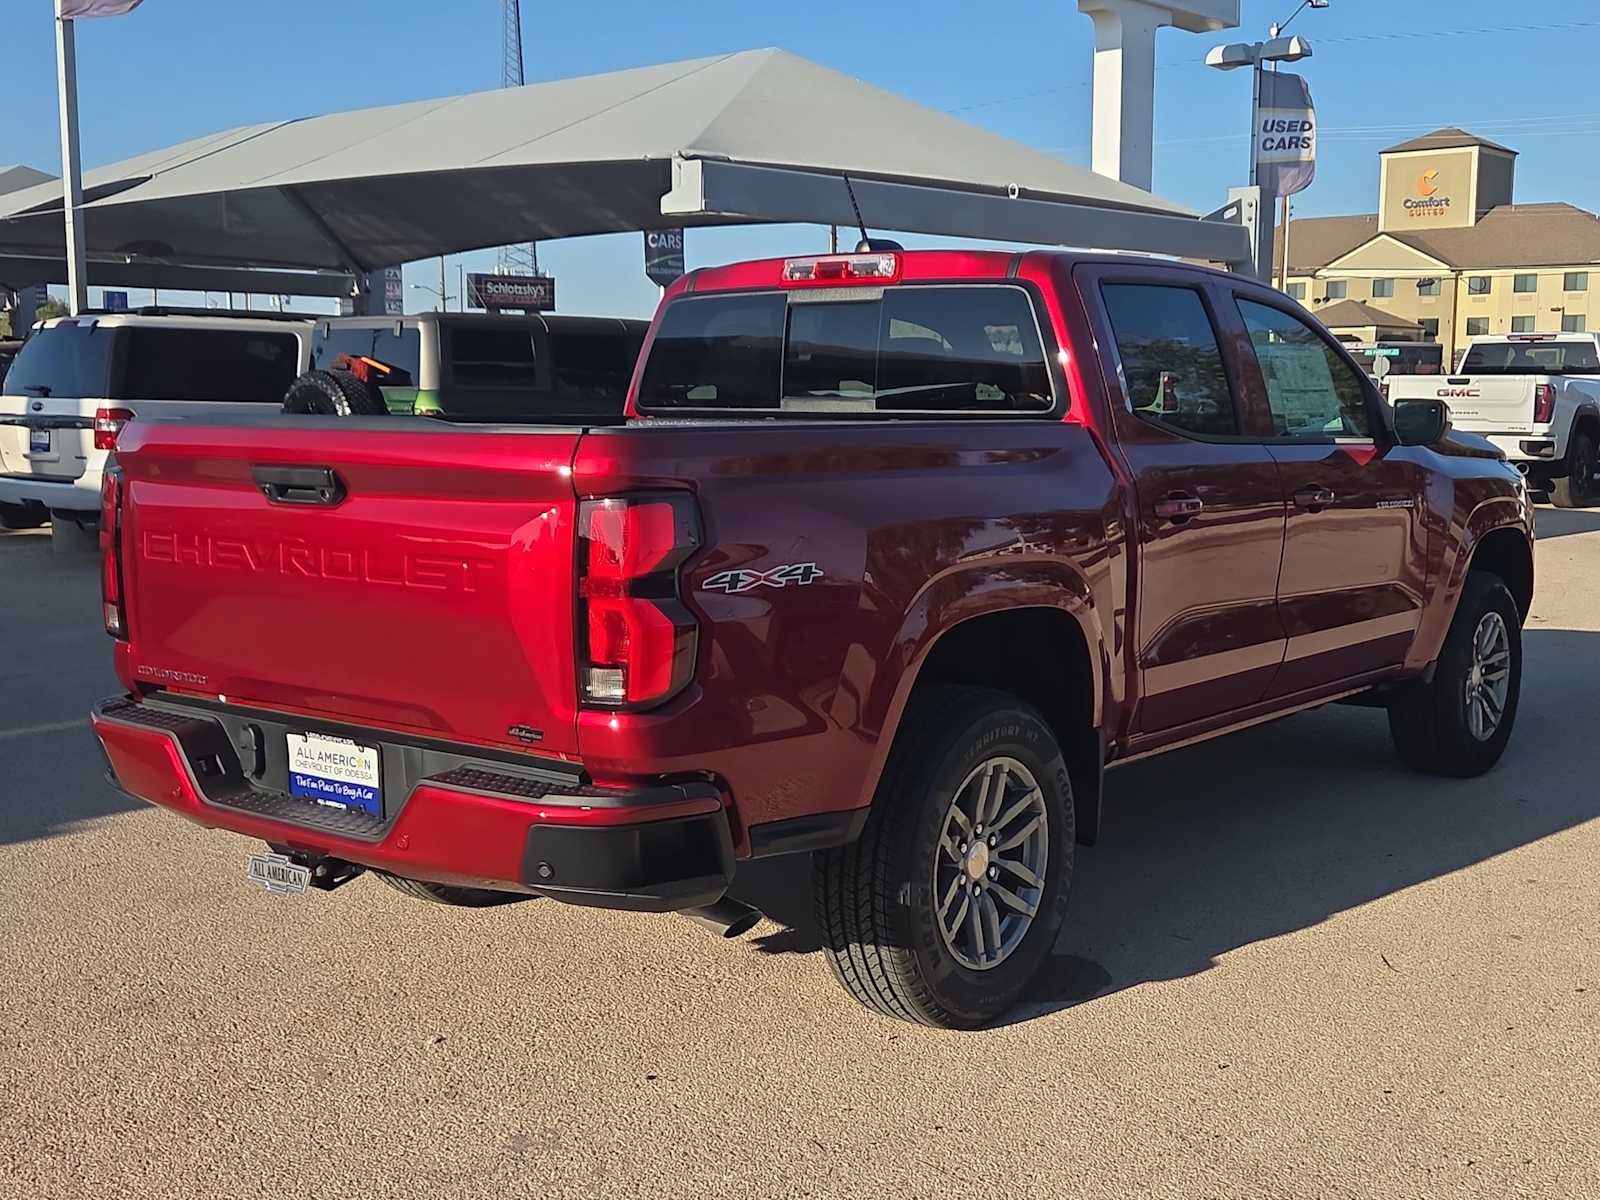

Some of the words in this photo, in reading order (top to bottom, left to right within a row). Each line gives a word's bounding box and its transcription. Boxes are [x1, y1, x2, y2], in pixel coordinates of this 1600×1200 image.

[1262, 119, 1313, 134] USED
[1262, 136, 1312, 151] CARS
[1403, 196, 1450, 209] Comfort
[1409, 208, 1447, 217] SUITES
[648, 233, 682, 249] CARS
[486, 281, 545, 298] Schlotzsky's
[1437, 388, 1481, 398] GMC
[143, 530, 495, 592] CHEVROLET
[297, 747, 315, 761] ALL
[317, 751, 371, 770] AMERICN
[295, 760, 333, 774] CHEVROLET
[334, 766, 344, 775] OF
[296, 775, 307, 787] The
[333, 783, 342, 794] To
[356, 787, 363, 798] A
[253, 861, 266, 877] ALL
[266, 864, 304, 887] AMERICAN
